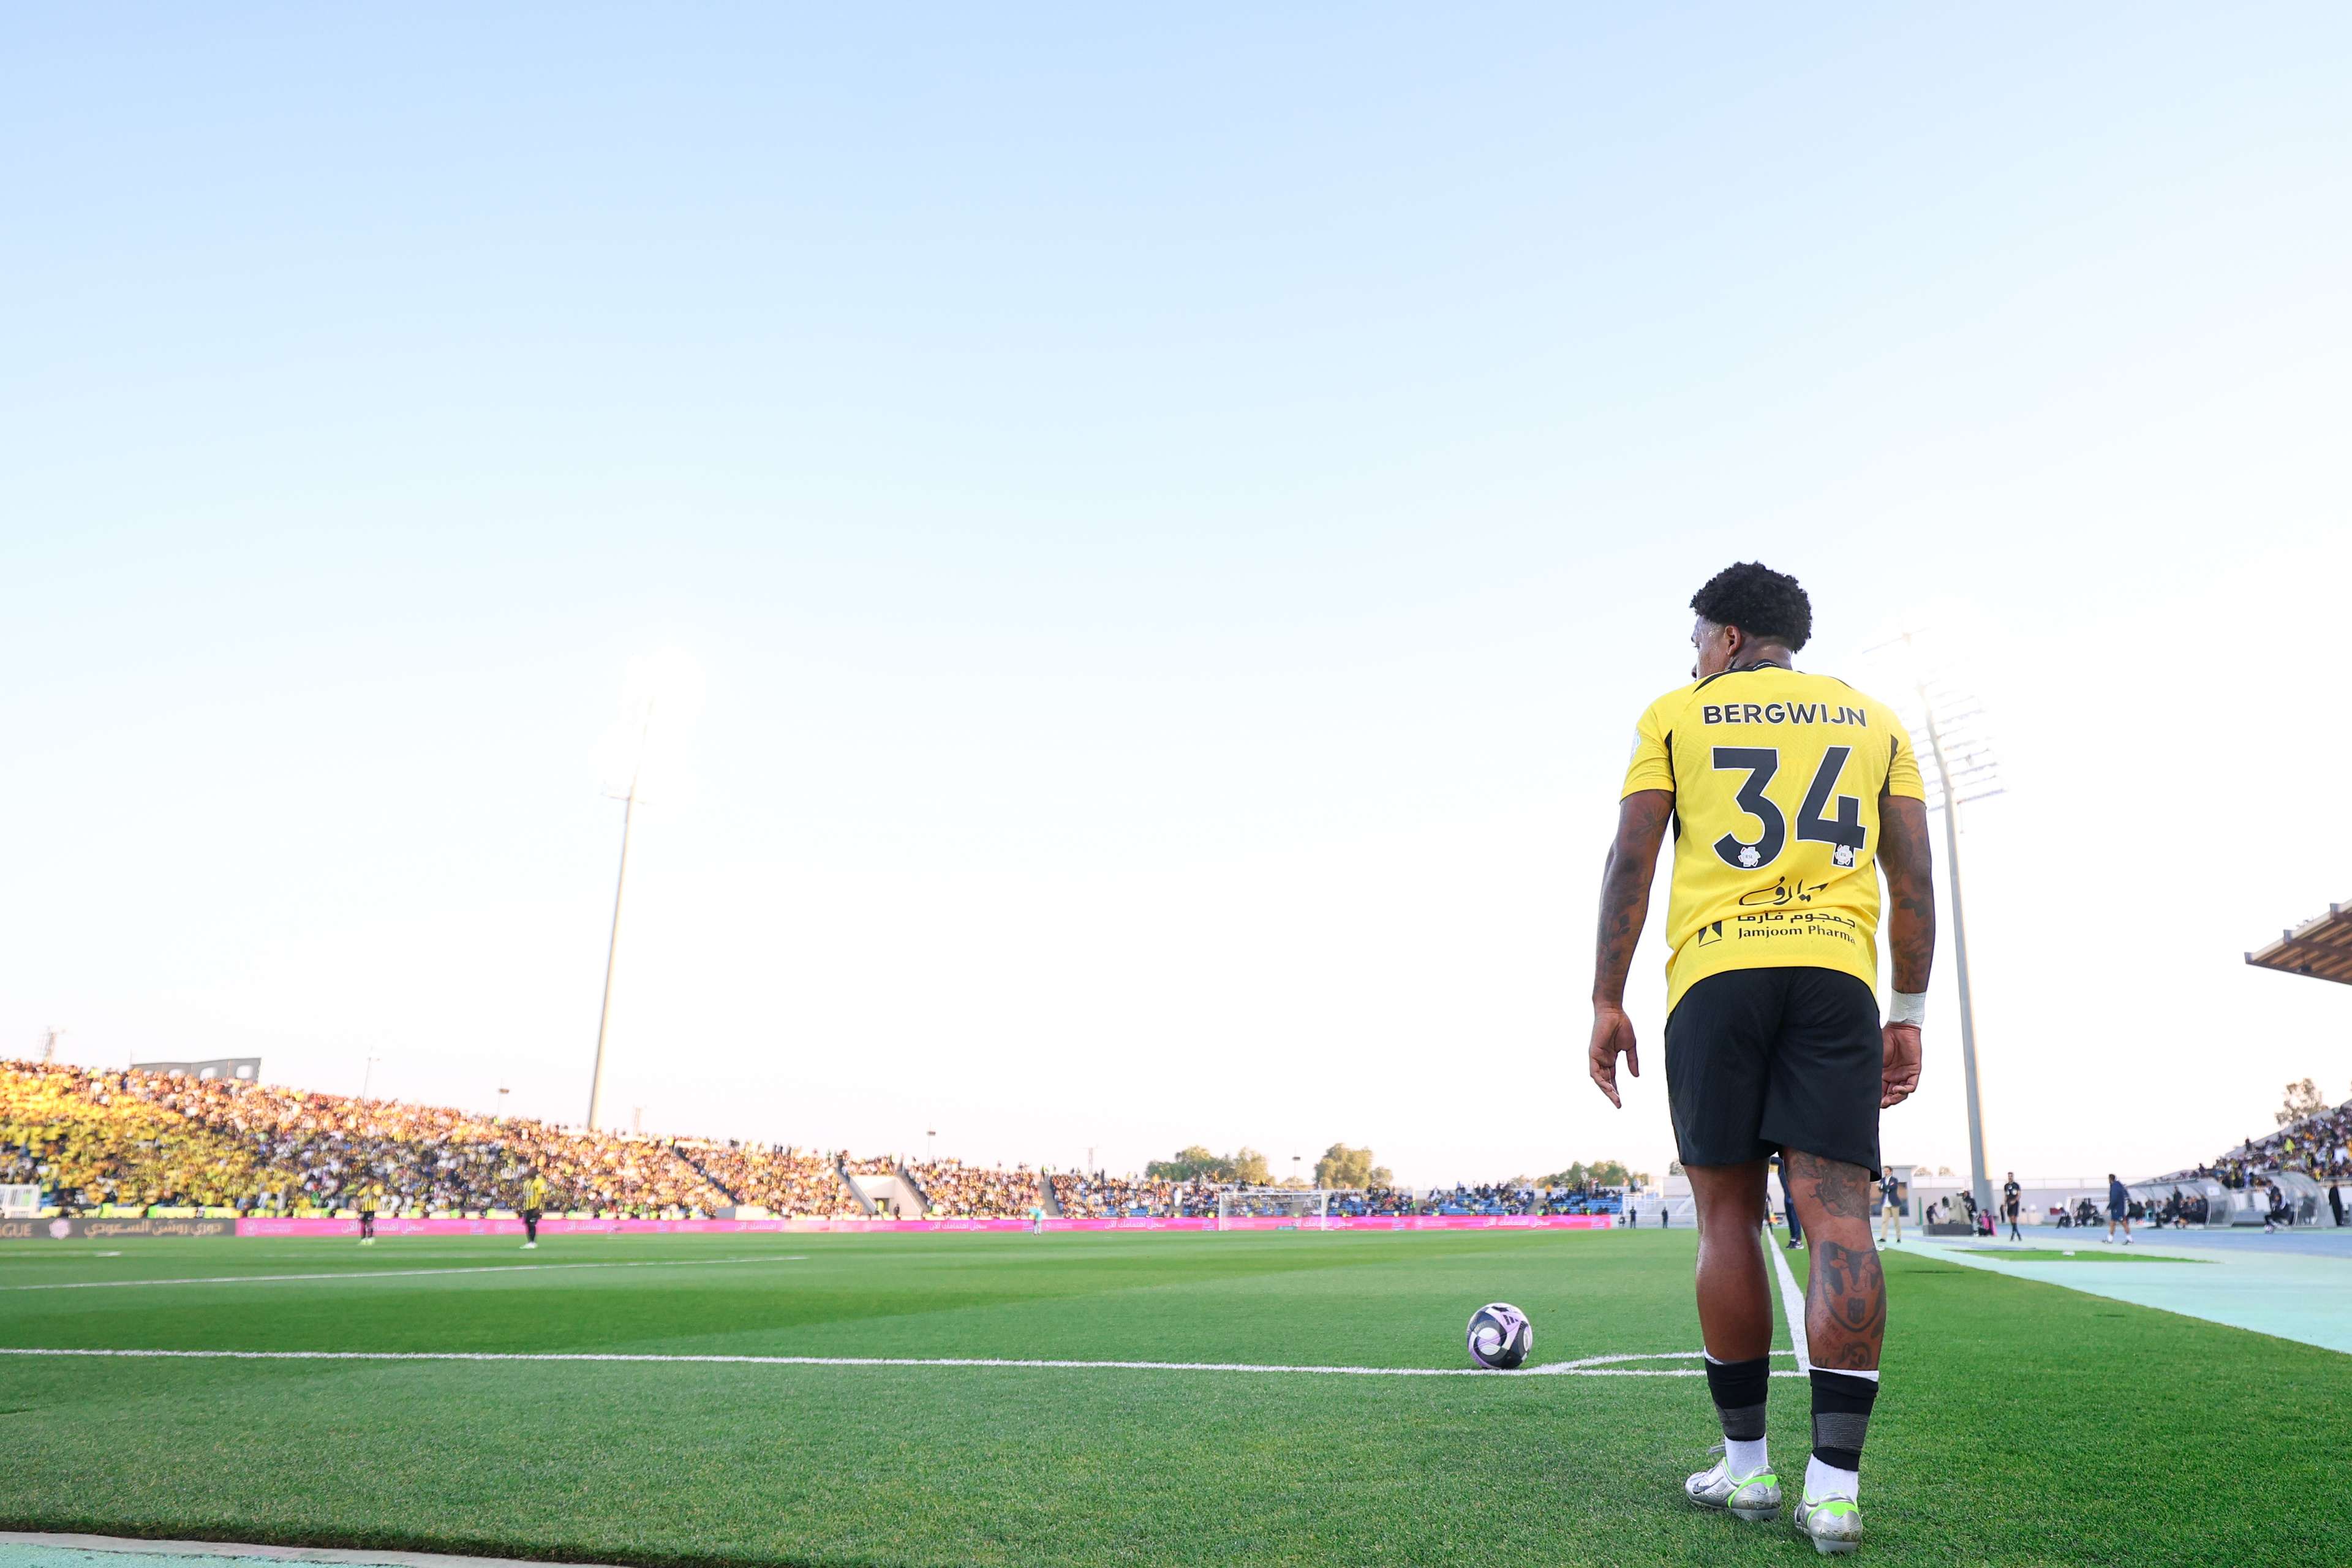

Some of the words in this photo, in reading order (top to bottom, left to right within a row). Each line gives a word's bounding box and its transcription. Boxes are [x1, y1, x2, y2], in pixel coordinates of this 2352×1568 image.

[1703, 702, 1866, 727] BERGWIJN
[1712, 745, 1866, 870] 34
[1790, 913, 1855, 929] جمجوم
[1738, 926, 1803, 940] Jamjoom
[1808, 925, 1856, 945] Pharma
[0, 1223, 32, 1237] GUE
[83, 1219, 151, 1239] السعودي
